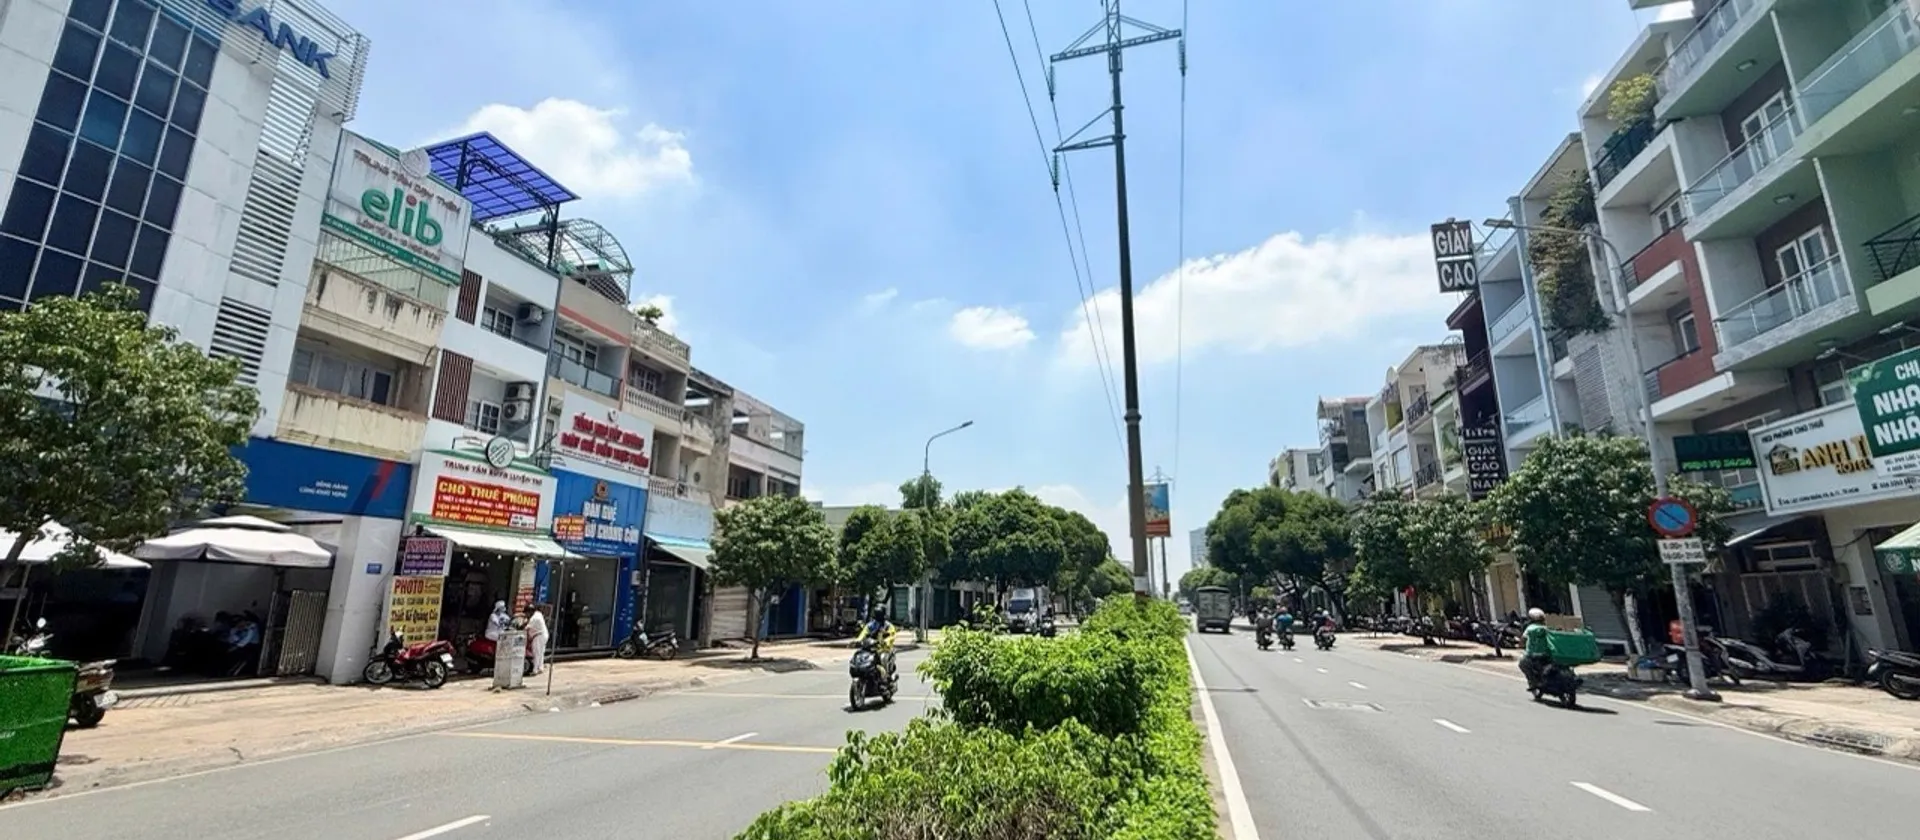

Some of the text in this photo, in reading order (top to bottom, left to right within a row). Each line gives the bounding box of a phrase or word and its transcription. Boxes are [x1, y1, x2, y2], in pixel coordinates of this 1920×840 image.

[361, 187, 444, 247] elib
[1435, 223, 1470, 255] GIÀY
[1440, 261, 1476, 288] CAO
[1471, 460, 1500, 472] CAO
[1801, 439, 1851, 469] ANH
[439, 481, 466, 496] CHO
[469, 484, 501, 501] THUÊ
[502, 491, 538, 507] PHÒNG
[394, 578, 424, 595] PHOTO
